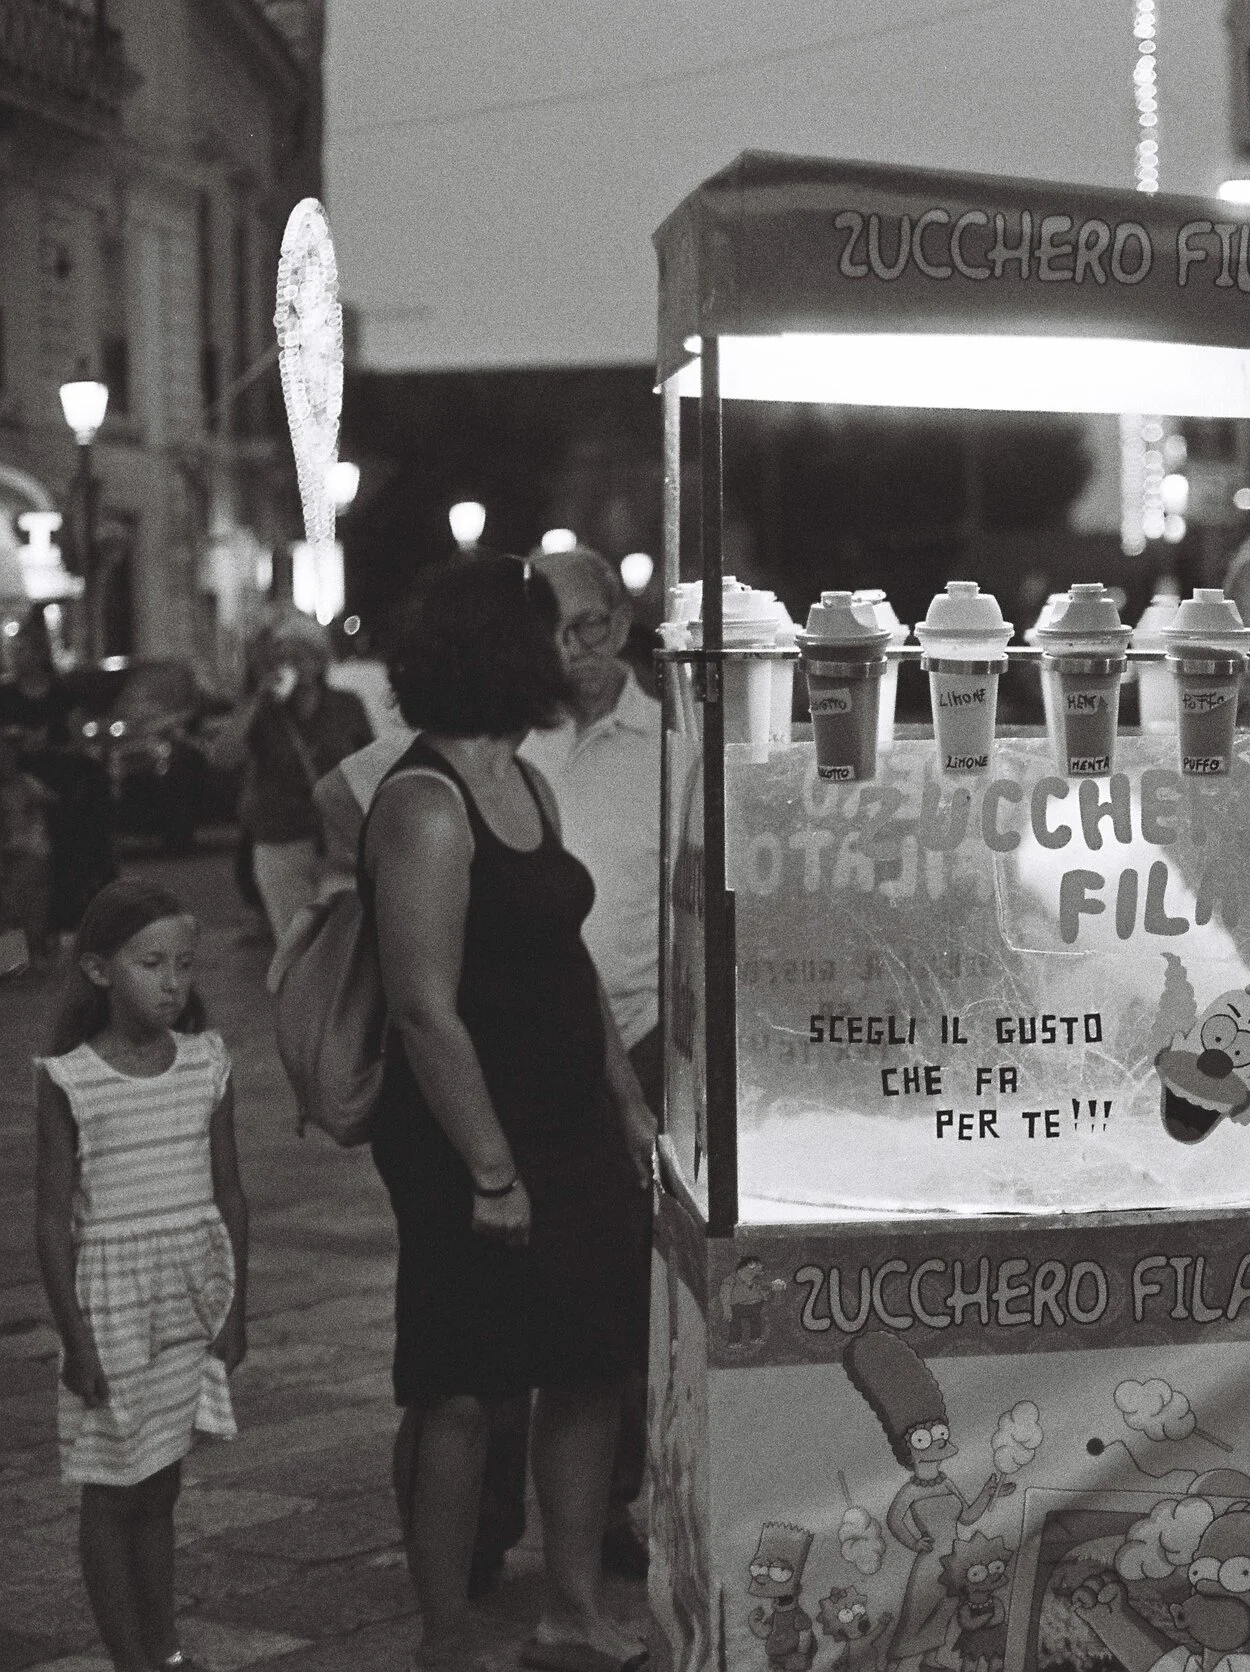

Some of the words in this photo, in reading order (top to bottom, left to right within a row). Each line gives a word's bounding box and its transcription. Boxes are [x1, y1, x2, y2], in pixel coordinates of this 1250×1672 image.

[835, 210, 1153, 284] ZUCCHERO
[940, 689, 986, 707] LIMONE
[1072, 756, 1109, 771] MENTA
[1183, 757, 1220, 771] PUFFO
[810, 1015, 916, 1045] SCEGLI
[942, 1015, 968, 1044] IL
[996, 1013, 1102, 1044] GUSTO
[881, 1066, 942, 1096] CHE
[976, 1067, 1018, 1095] FA
[937, 1110, 1000, 1141] PER
[796, 1256, 1110, 1333] ZUCCHERO
